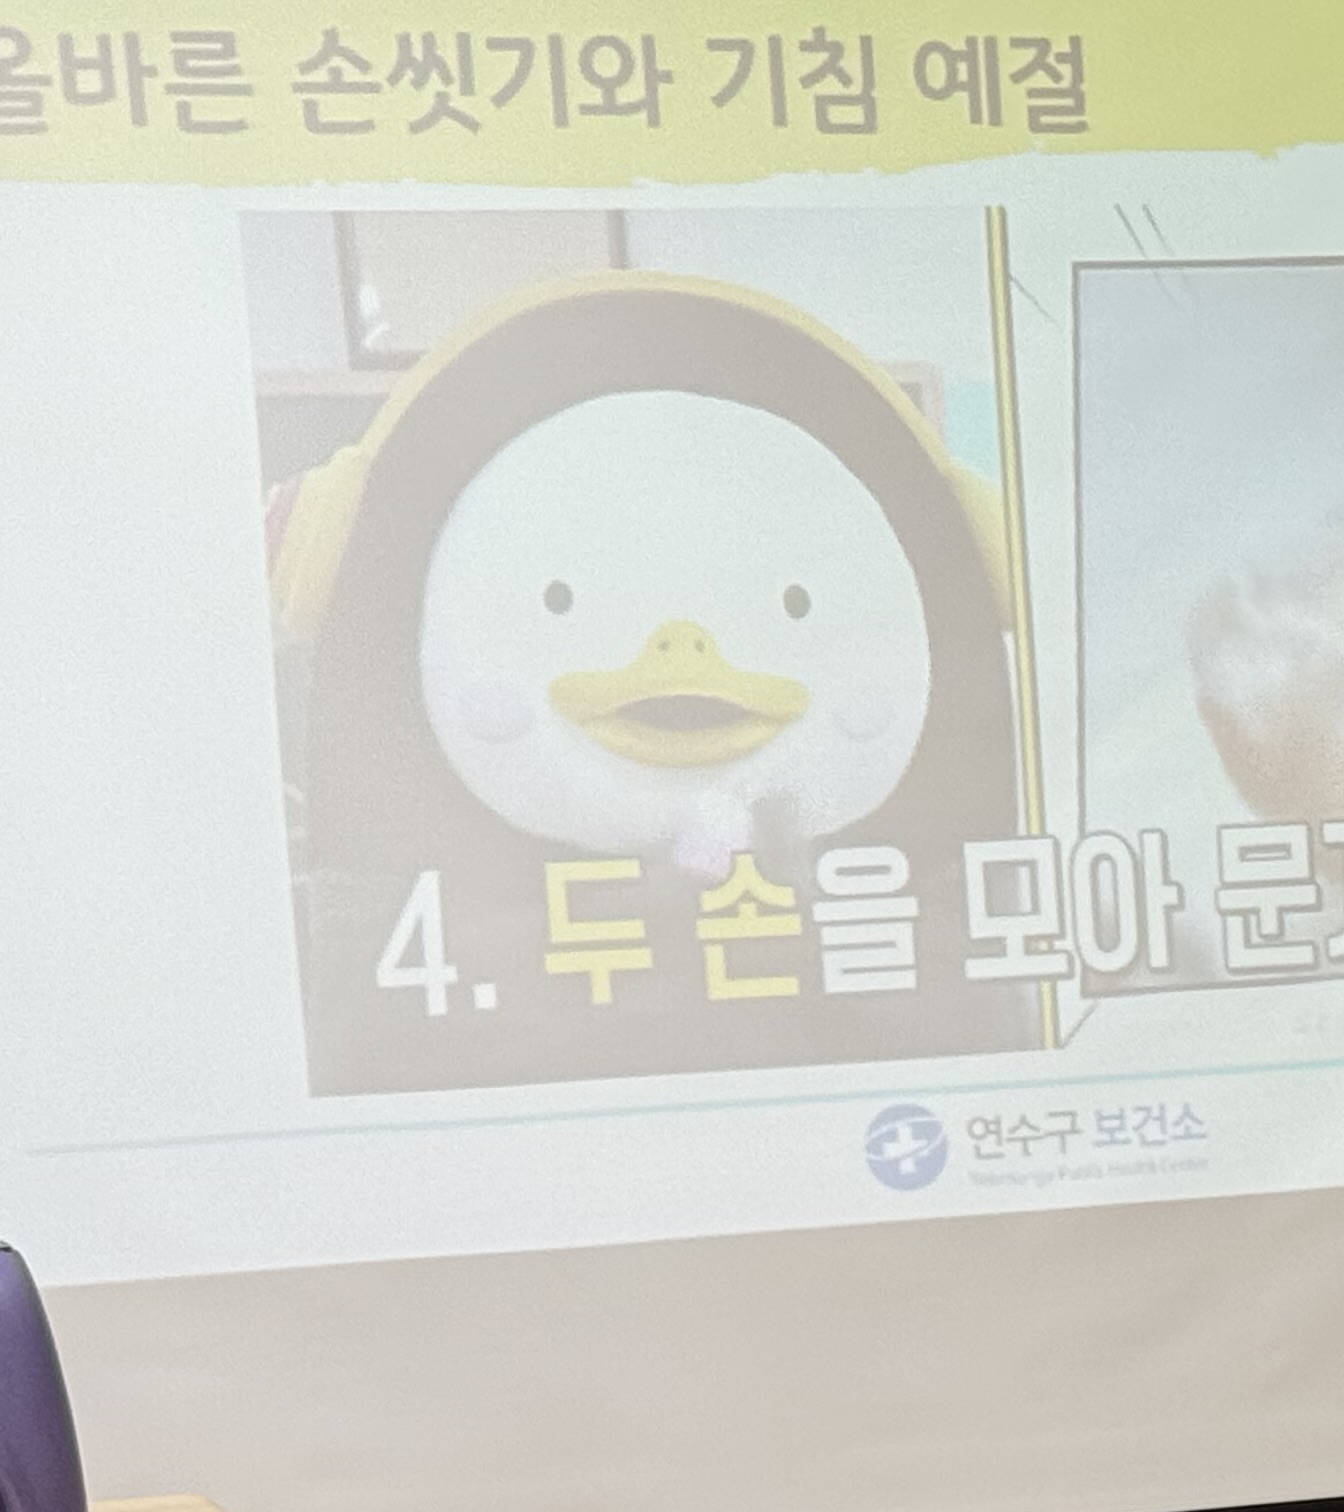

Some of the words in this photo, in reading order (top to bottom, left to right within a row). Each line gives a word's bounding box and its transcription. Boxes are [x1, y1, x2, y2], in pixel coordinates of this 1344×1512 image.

[0, 25, 254, 135] 올바른
[291, 27, 674, 135] 손씻기와
[705, 26, 877, 135] 기침
[913, 35, 1090, 135] 예절
[376, 869, 497, 1016] 4.
[544, 858, 653, 1004] 두
[696, 845, 920, 1001] 손을
[963, 827, 1185, 982] 모아
[967, 1108, 1084, 1160] 연수구
[1092, 1101, 1207, 1148] 보건소
